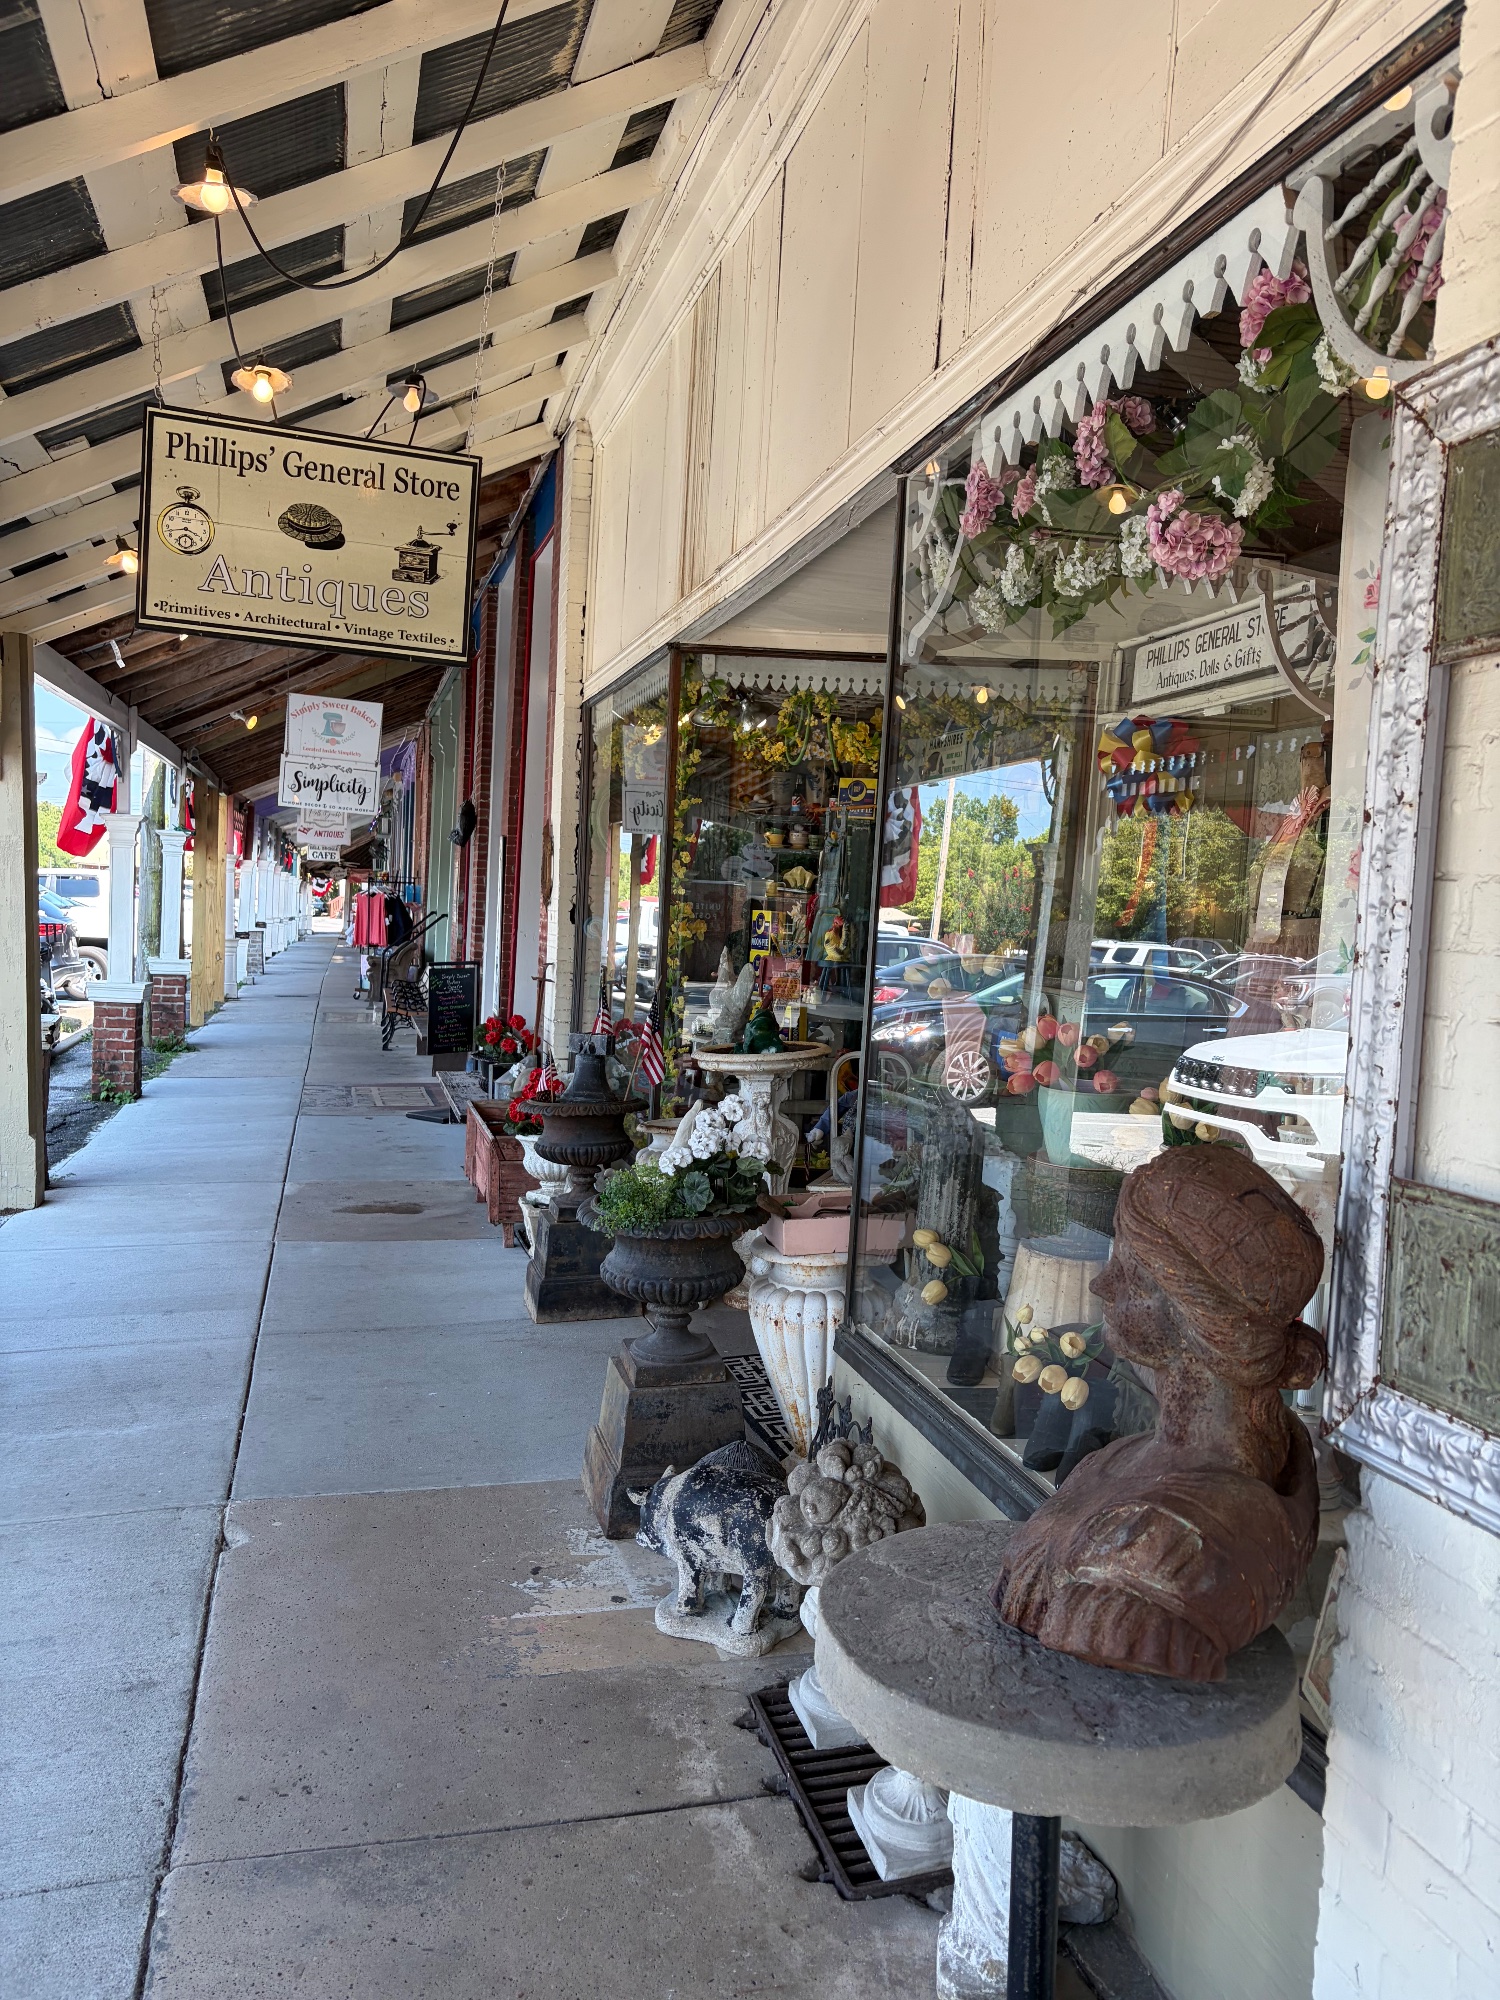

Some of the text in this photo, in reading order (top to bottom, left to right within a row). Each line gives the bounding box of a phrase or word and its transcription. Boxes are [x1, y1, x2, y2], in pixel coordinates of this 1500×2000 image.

[283, 450, 385, 491] General
[393, 467, 460, 501] Store
[197, 554, 430, 619] Antiques
[243, 611, 332, 632] Architectural
[343, 623, 394, 641] Vintage
[397, 629, 447, 646] Textiles
[1146, 638, 1190, 669] PHILLIPS
[1195, 622, 1242, 654] GENERAL
[1200, 657, 1220, 678] Dolls
[1223, 653, 1233, 670] &
[1234, 646, 1262, 668] Gifts
[290, 701, 378, 728] Simply Sweet Bakery
[338, 750, 361, 758] Simplicity
[287, 770, 371, 805] Simplicity
[314, 830, 345, 839] ANTIQUES
[312, 851, 337, 860] CAFE
